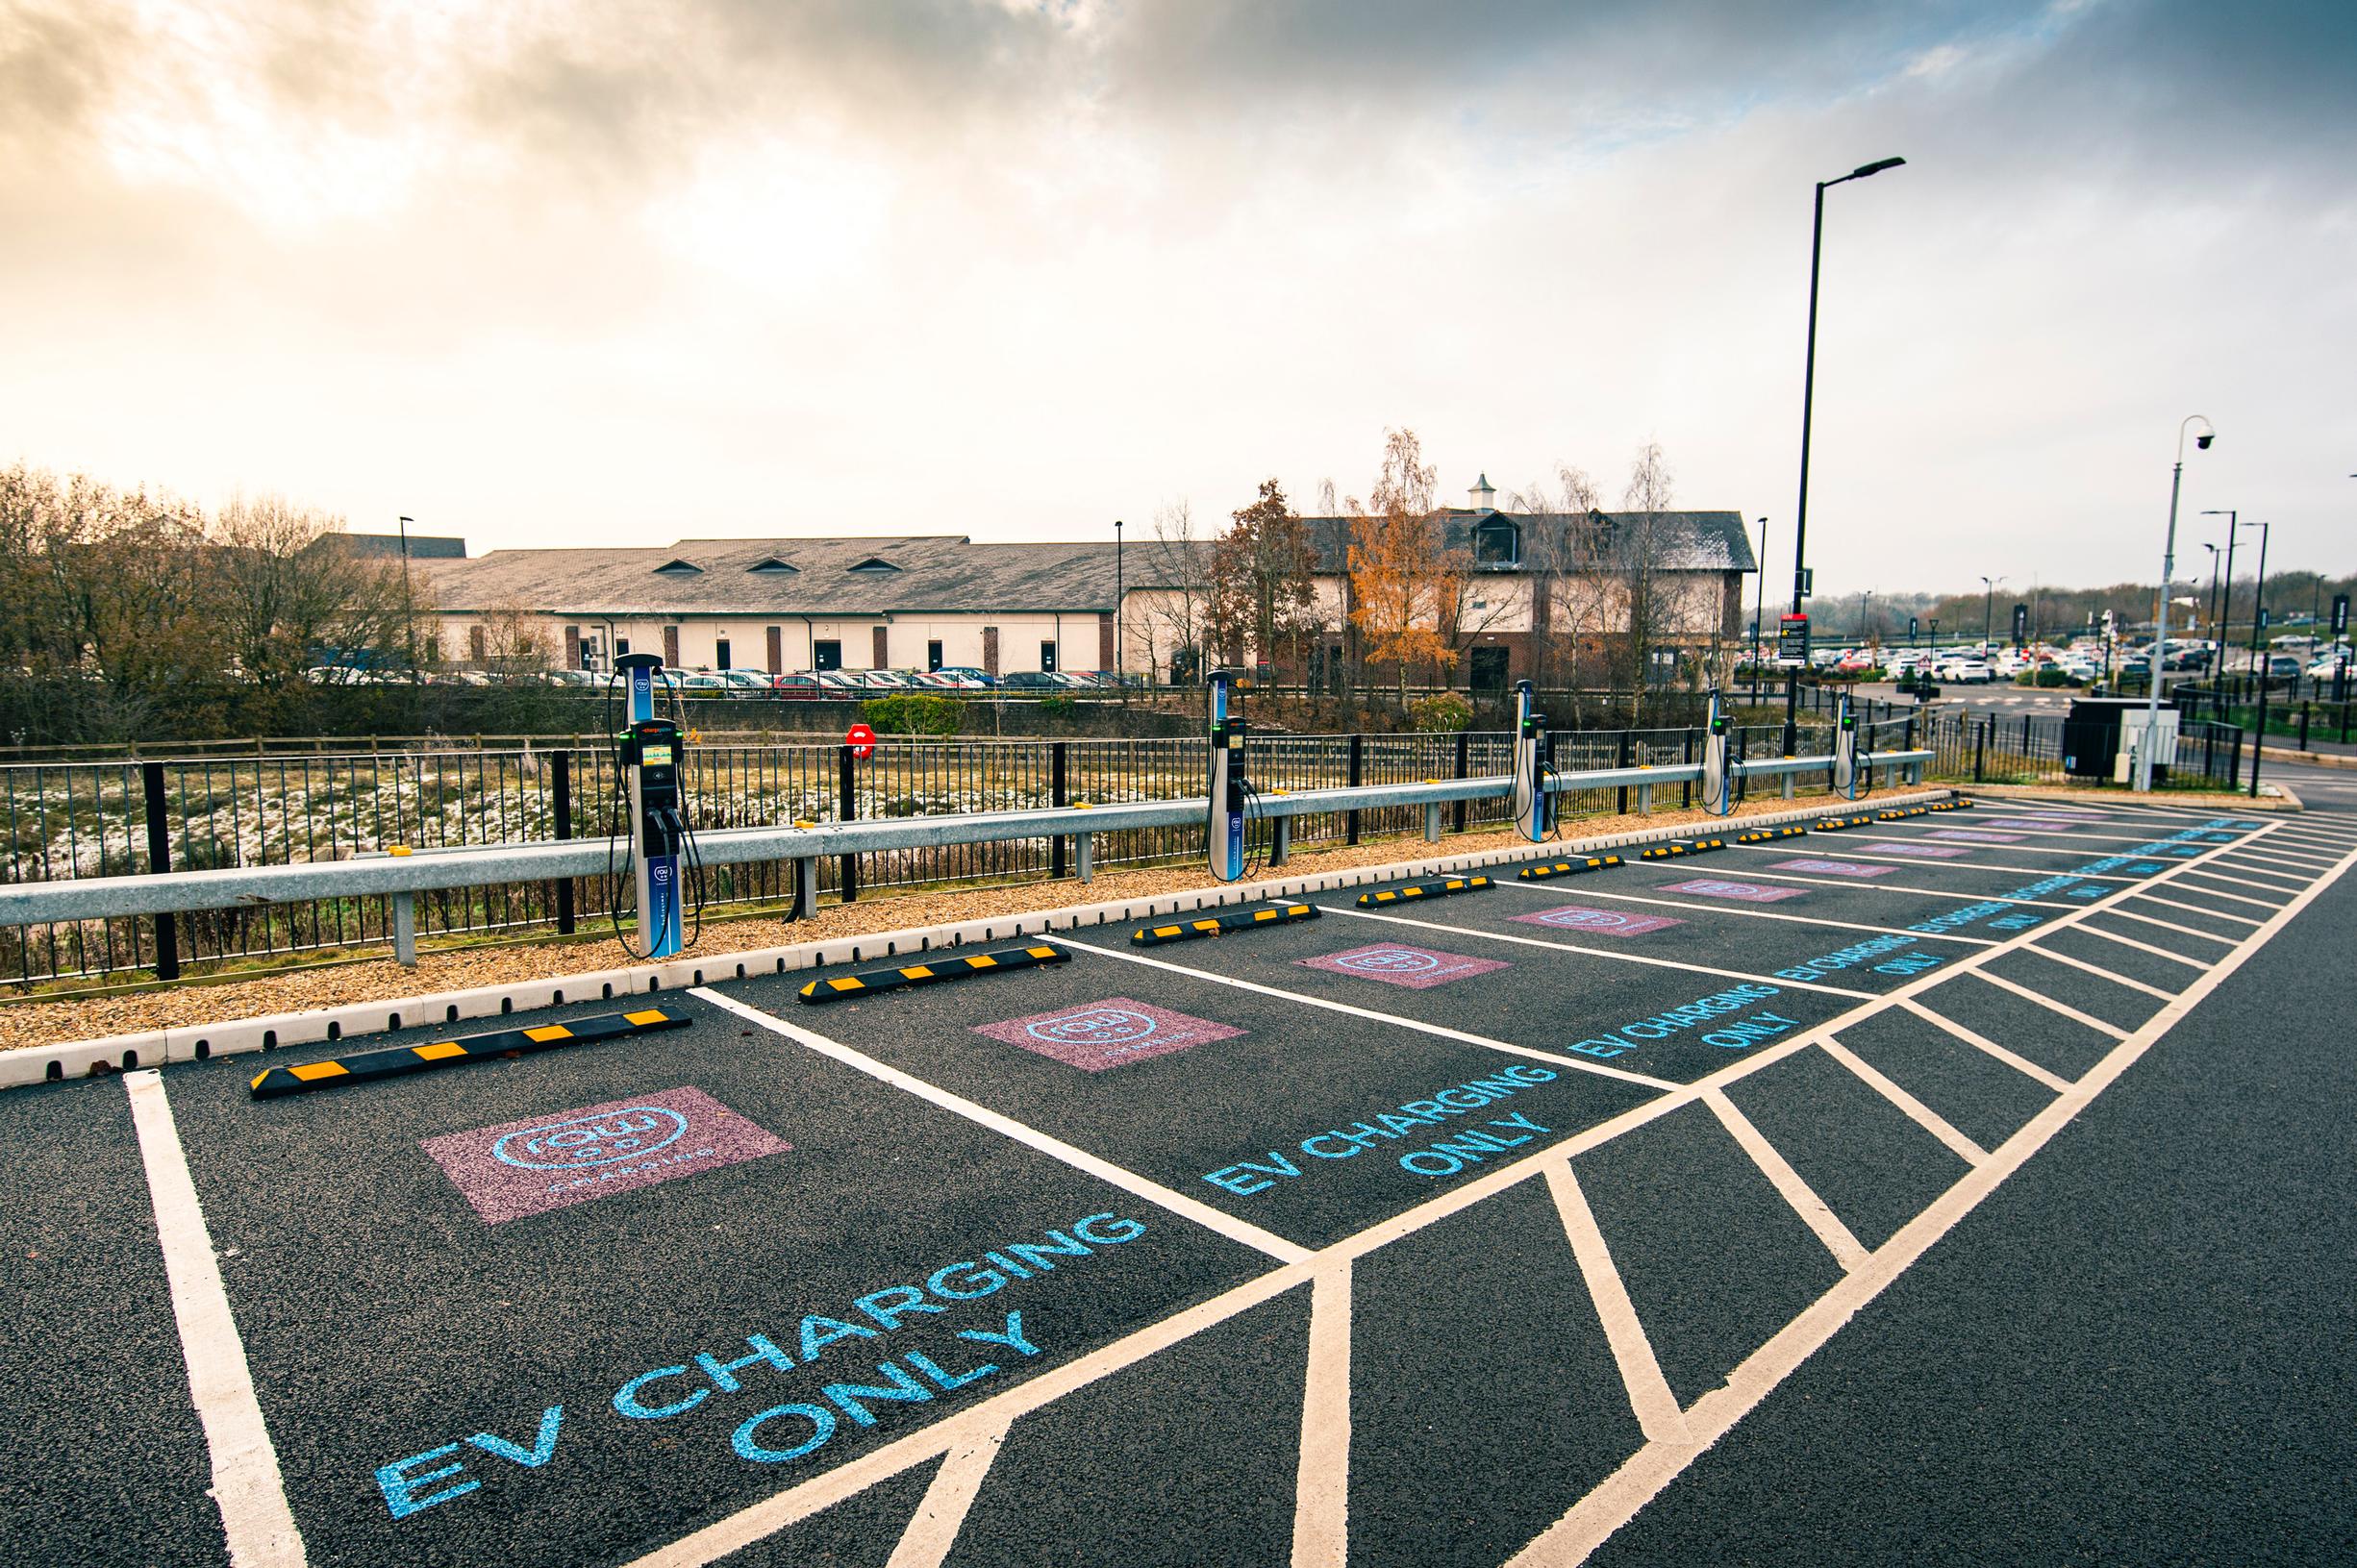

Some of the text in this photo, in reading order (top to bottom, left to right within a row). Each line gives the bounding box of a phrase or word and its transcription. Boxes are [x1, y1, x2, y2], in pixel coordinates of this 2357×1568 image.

[1772, 934, 1918, 982] EV CHARGING
[1874, 952, 1945, 975] ONLY
[1567, 983, 1779, 1058] EV CHARGING
[1701, 1011, 1800, 1049] ONLY
[1202, 1064, 1557, 1197] EV CHARGING
[1399, 1110, 1552, 1177] ONLY
[548, 1147, 715, 1194] CHARGING
[374, 1210, 1147, 1521] EV CHARGING
[731, 1310, 1043, 1463] ONLY
